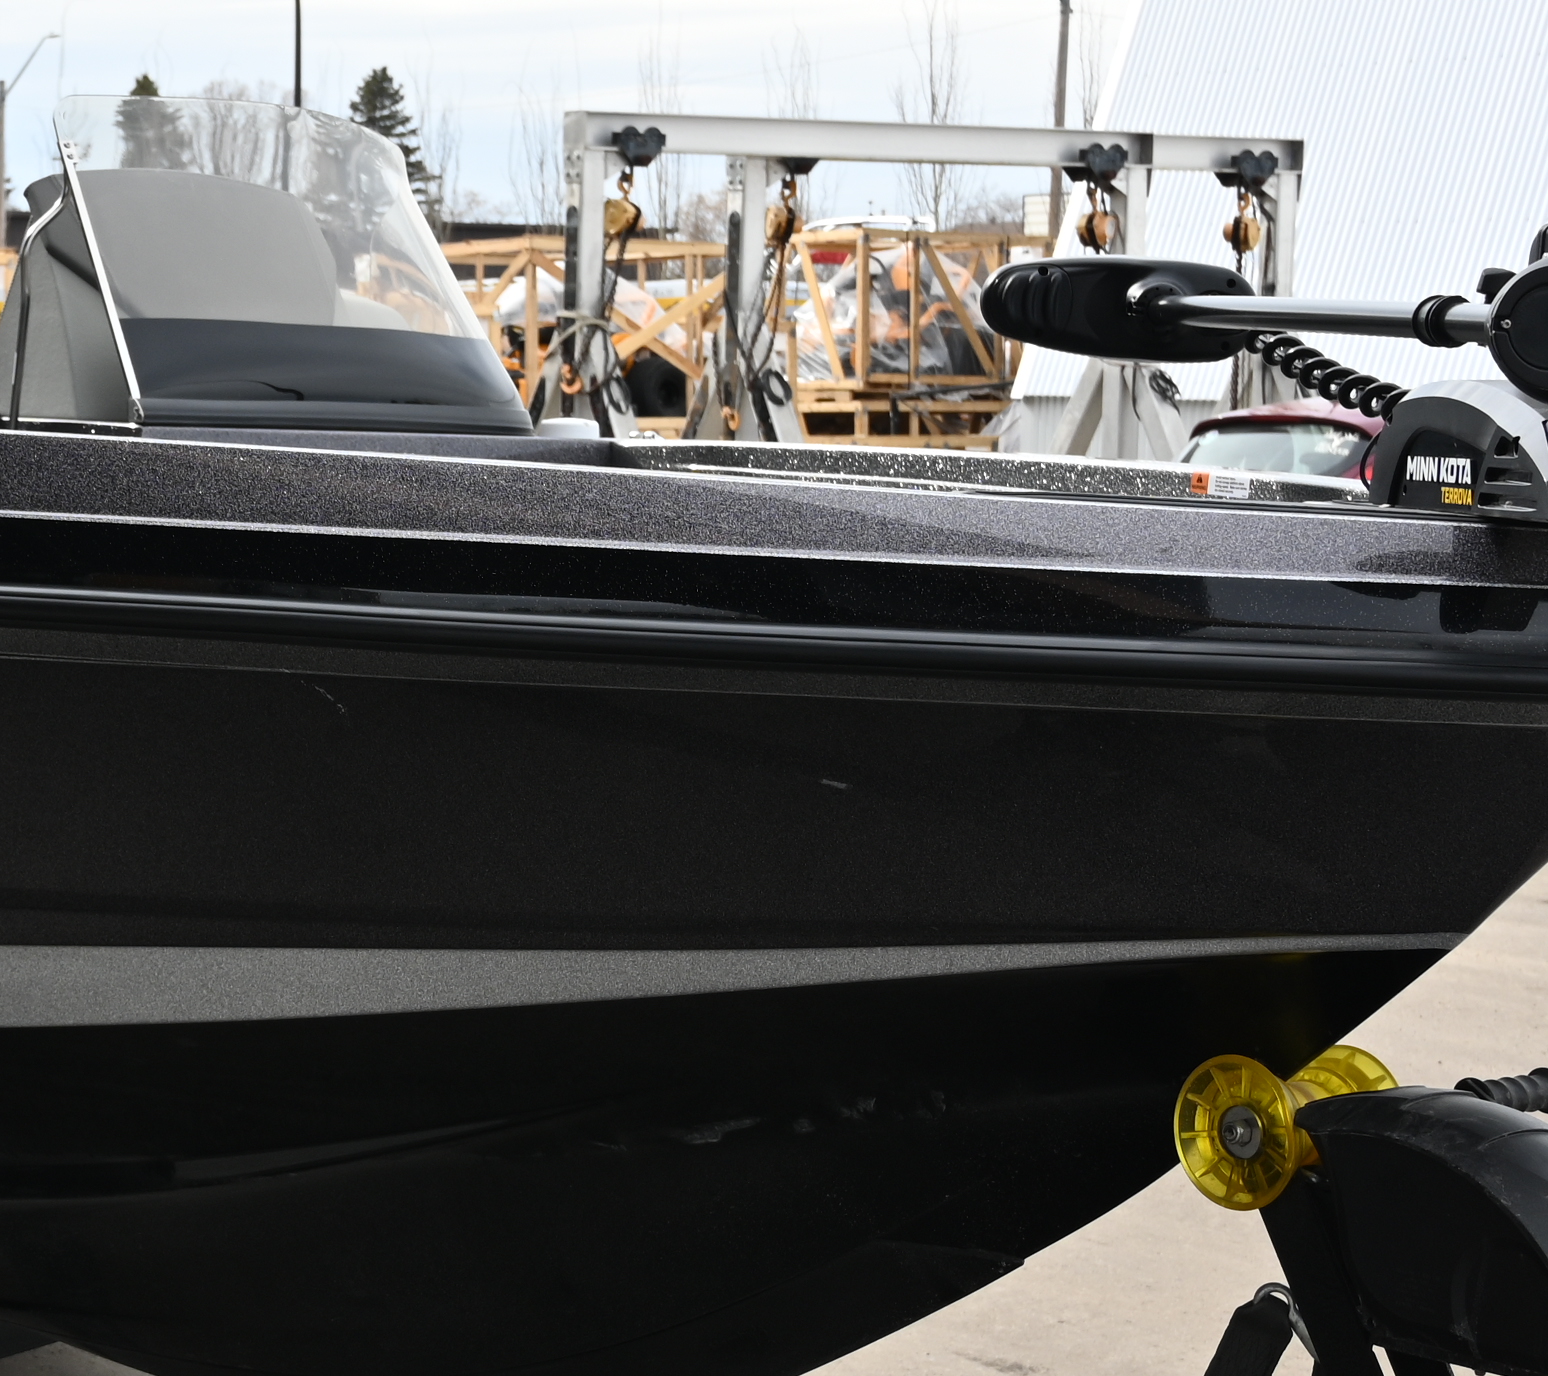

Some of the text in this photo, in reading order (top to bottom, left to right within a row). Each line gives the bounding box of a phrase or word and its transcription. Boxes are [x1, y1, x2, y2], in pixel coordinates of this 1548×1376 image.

[1406, 455, 1472, 485] MINN KOTA
[1440, 486, 1473, 506] TERROVA
